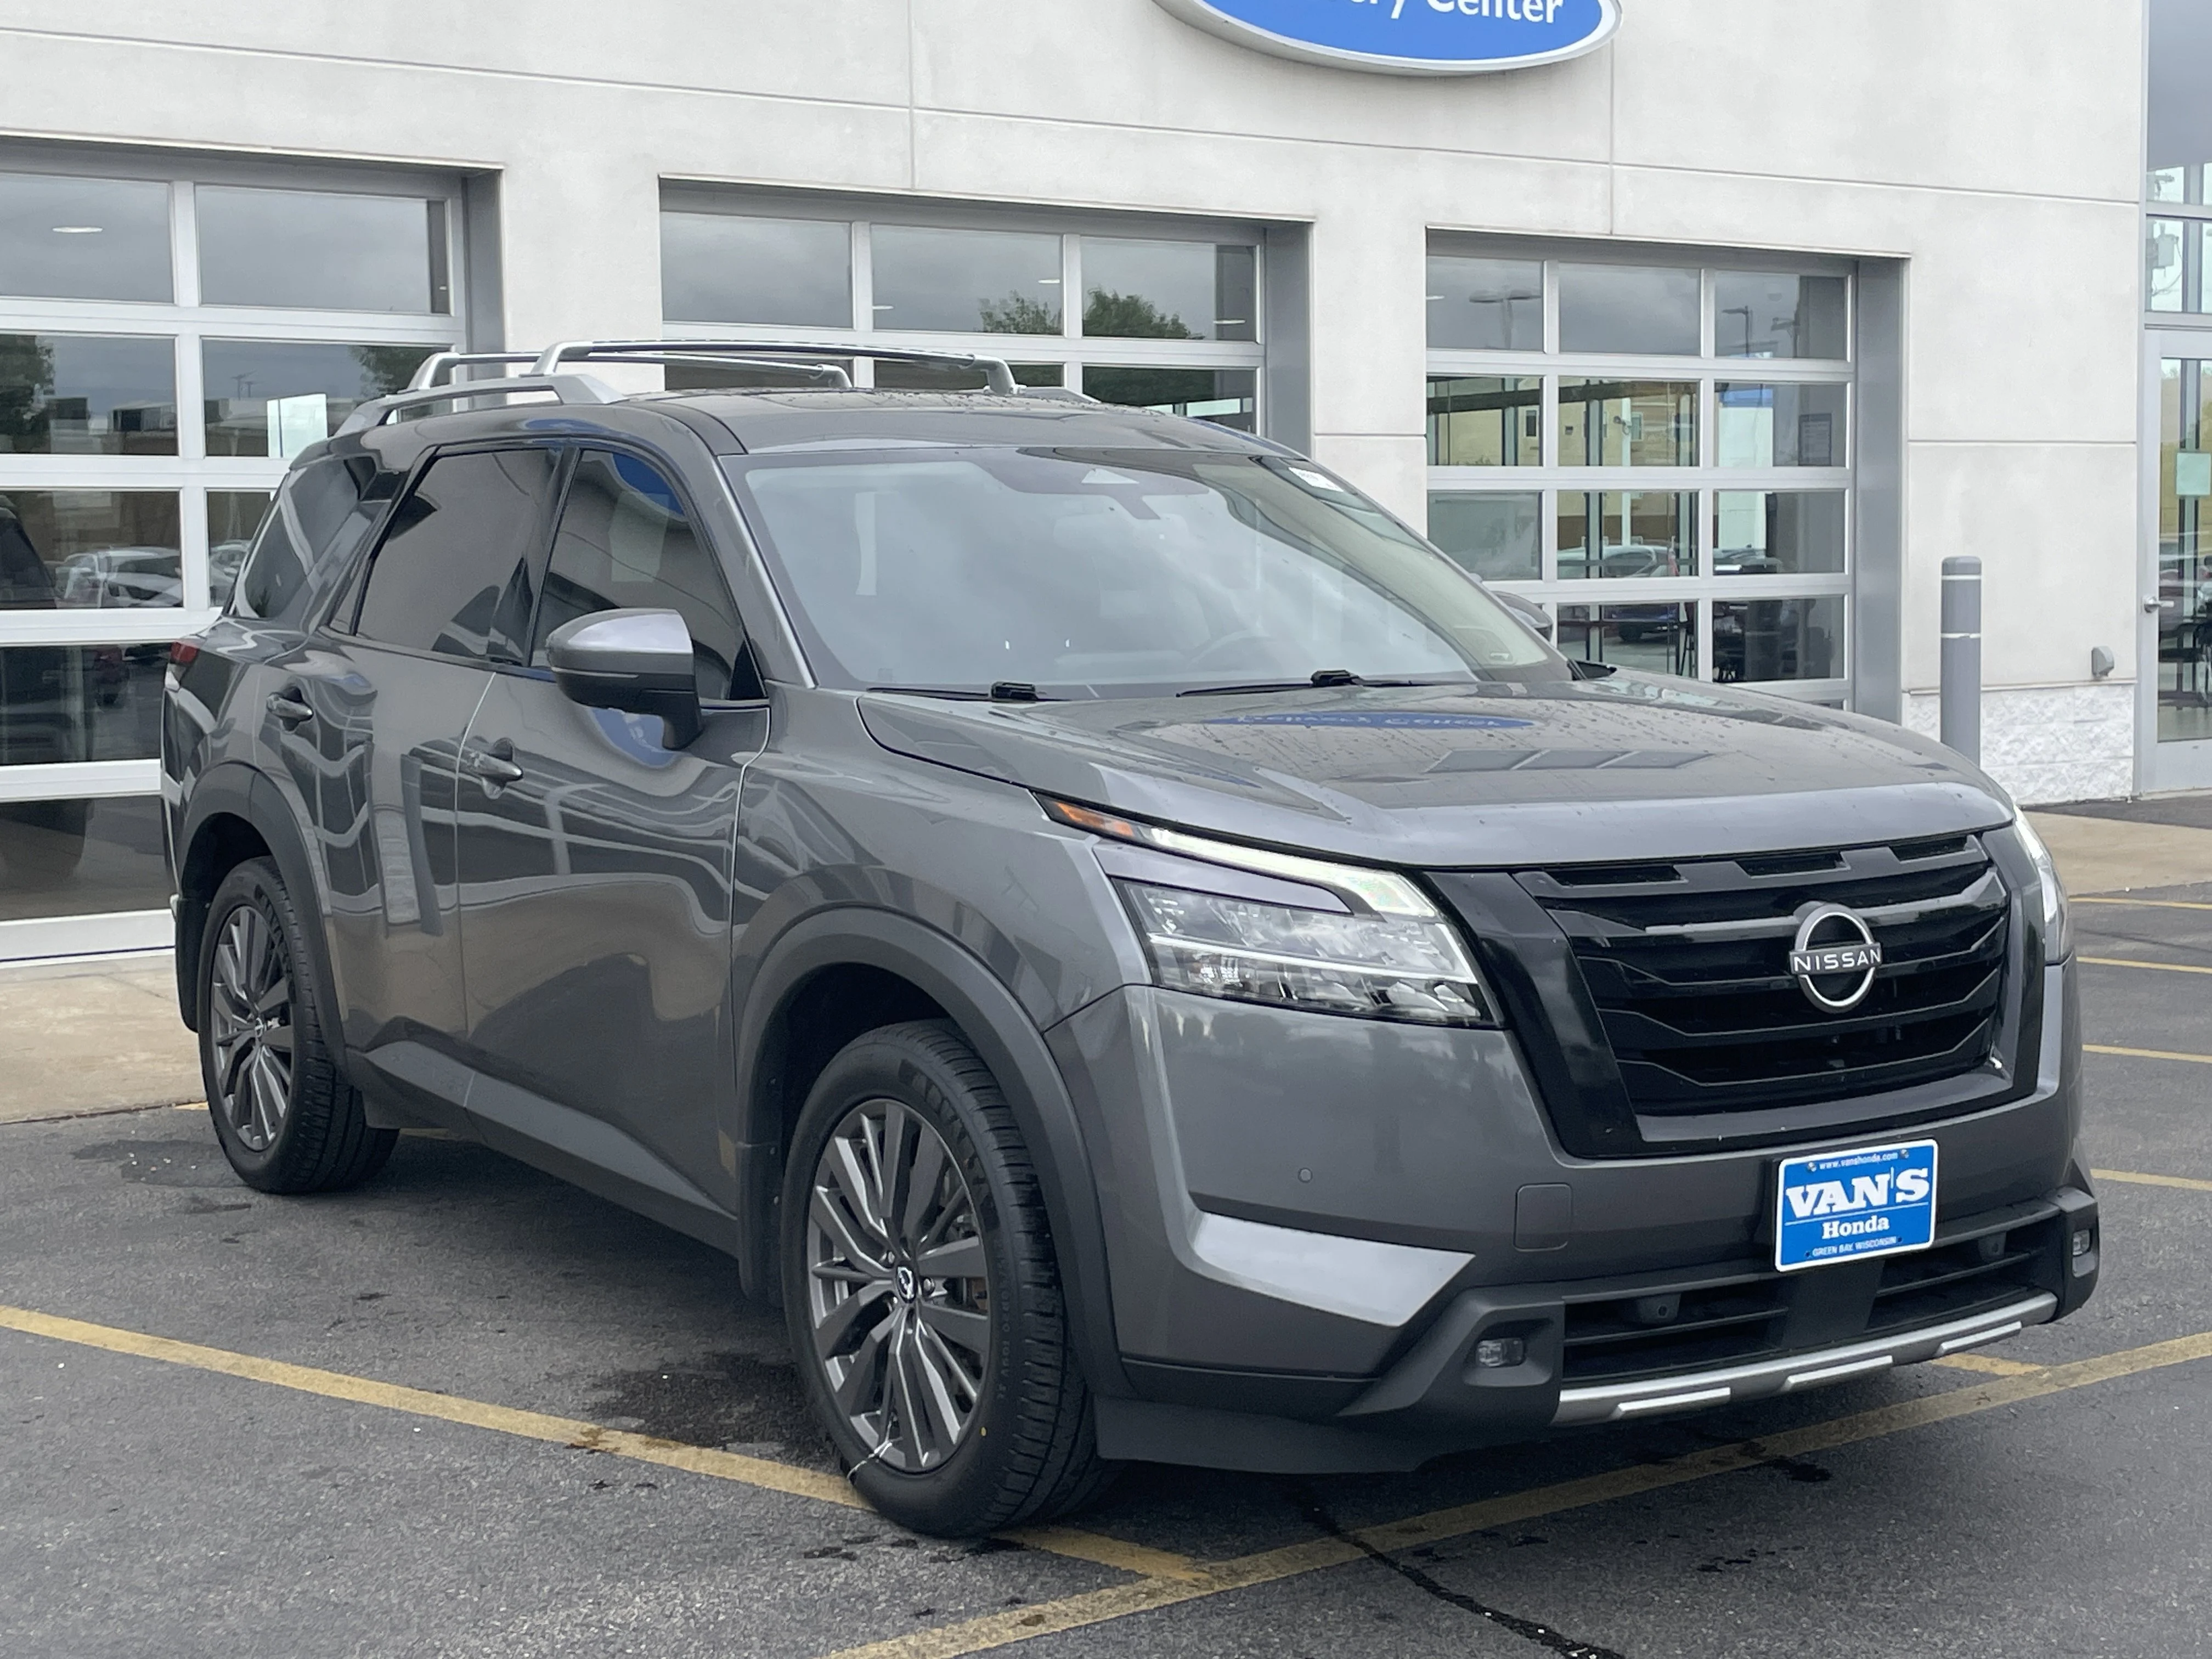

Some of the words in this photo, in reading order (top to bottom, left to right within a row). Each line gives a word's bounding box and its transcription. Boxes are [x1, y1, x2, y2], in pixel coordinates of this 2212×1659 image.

[1793, 947, 1881, 972] NISSAN
[1786, 1167, 1929, 1218] VAN'S
[1821, 1215, 1889, 1239] Honda
[1812, 1245, 1837, 1257] GREEN
